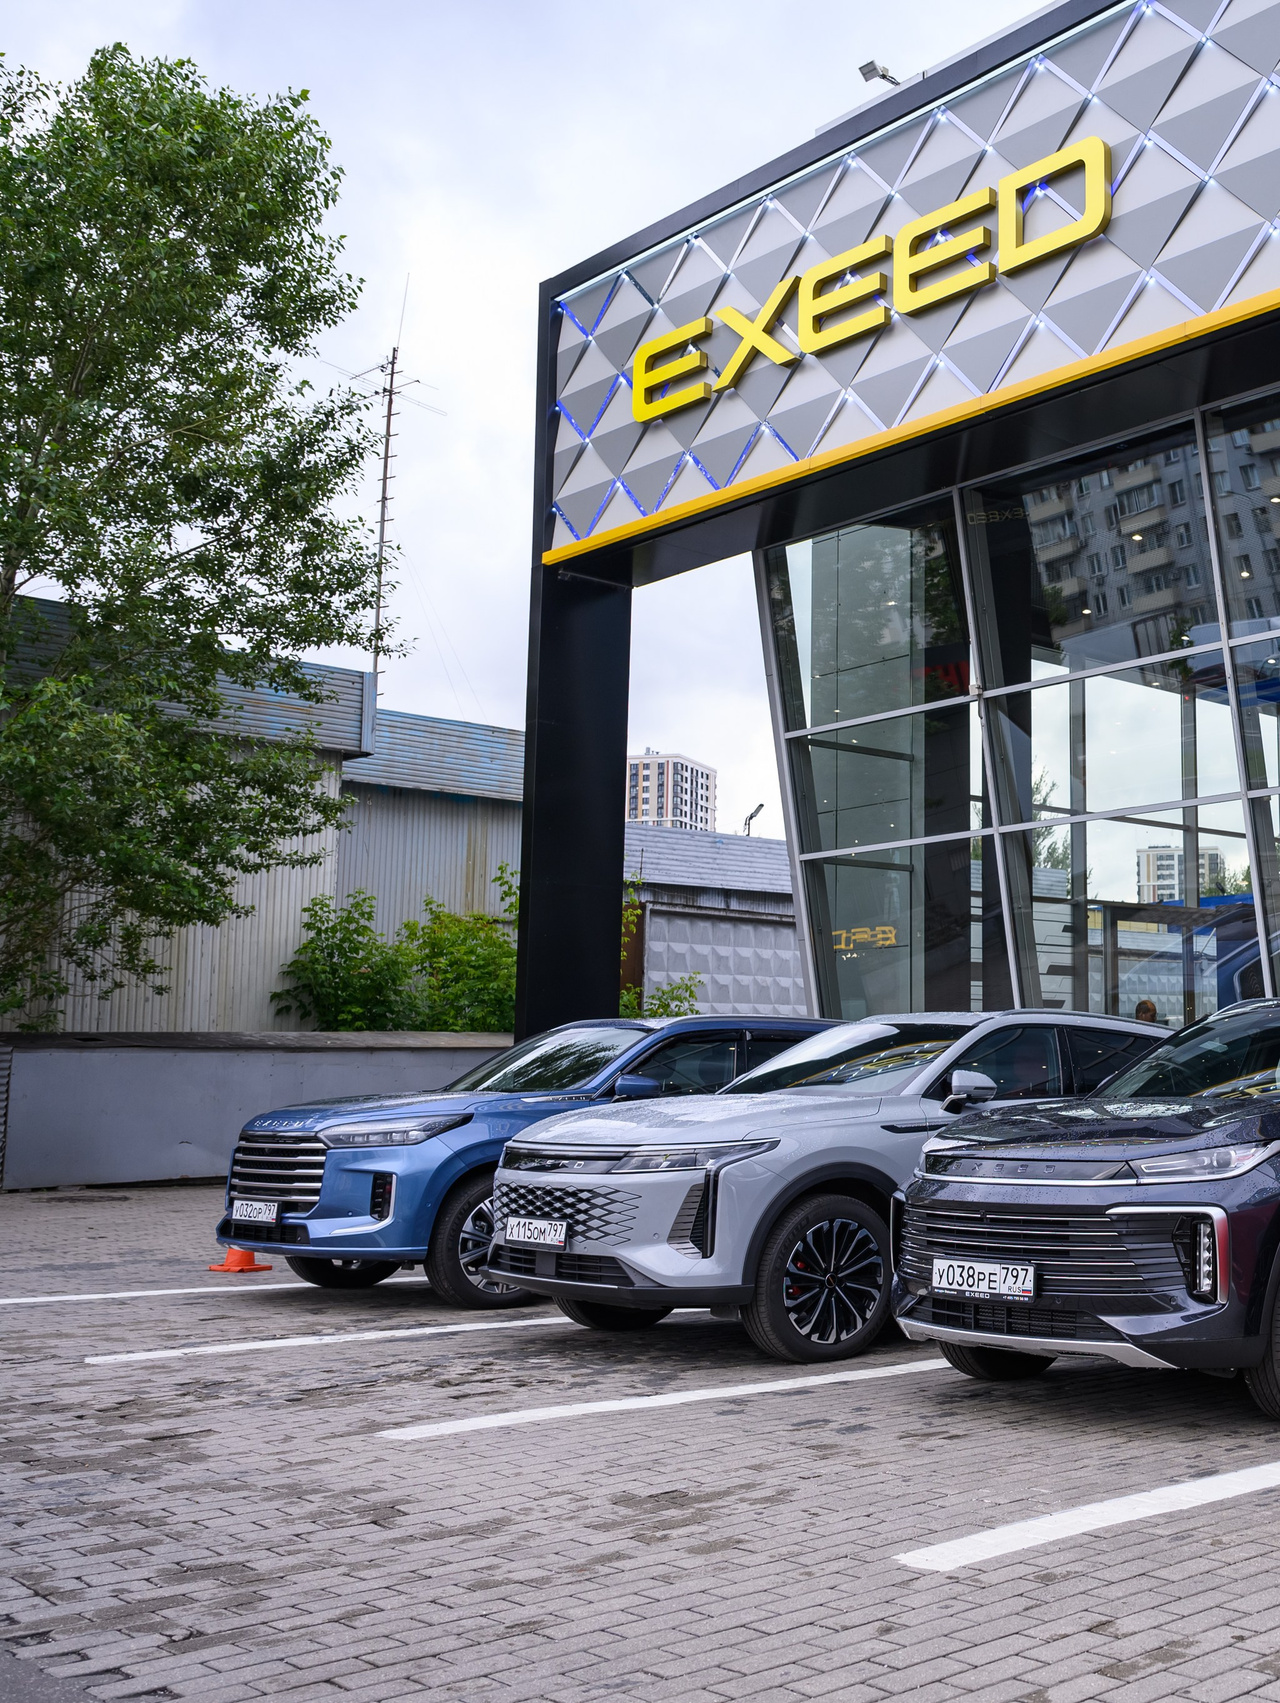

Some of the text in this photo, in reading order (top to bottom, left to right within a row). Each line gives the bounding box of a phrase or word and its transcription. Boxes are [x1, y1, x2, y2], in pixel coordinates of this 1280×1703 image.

[631, 135, 1112, 424] EXEED
[952, 1161, 1056, 1174] EXEED
[263, 1203, 276, 1216] 797
[547, 1222, 564, 1238] 797
[1001, 1266, 1029, 1285] 797
[965, 1291, 990, 1299] EXEED
[1007, 1285, 1022, 1293] RUS
